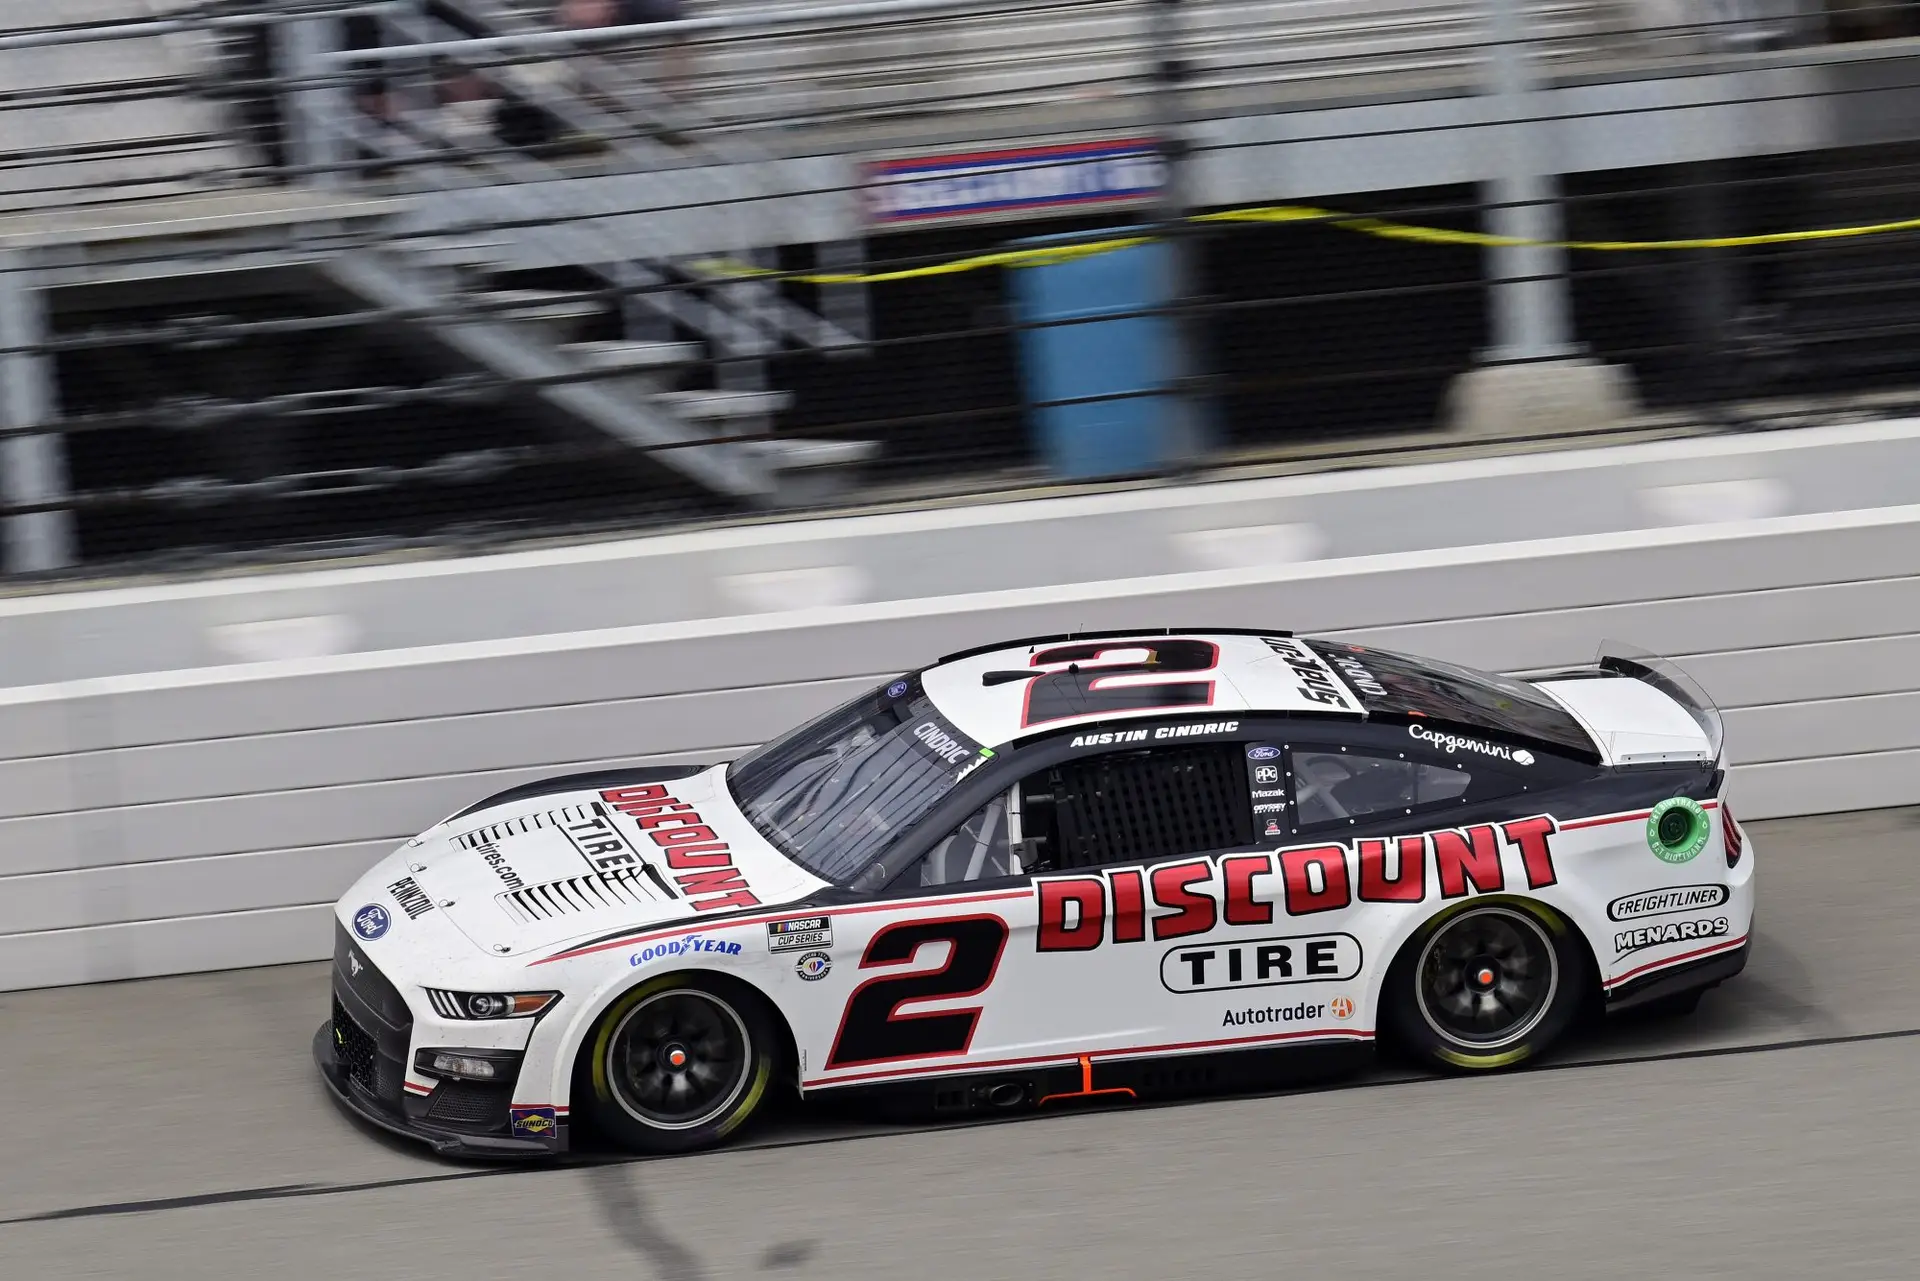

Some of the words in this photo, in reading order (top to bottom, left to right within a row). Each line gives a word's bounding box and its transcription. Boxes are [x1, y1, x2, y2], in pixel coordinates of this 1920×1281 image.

[1020, 639, 1220, 729] 2
[913, 721, 970, 764] CINDRIC
[1070, 729, 1149, 748] AUSTIN
[1154, 721, 1239, 739] CINDRIC
[1408, 724, 1512, 760] Capgemini
[1257, 767, 1276, 780] PPG
[1251, 788, 1285, 798] Mazak
[568, 818, 643, 880] TIRE
[599, 784, 763, 912] DISCOUNT
[476, 842, 525, 891] tires.com
[1034, 815, 1559, 953] DISCOUNT
[386, 876, 435, 921] PENNZOIL
[1617, 889, 1718, 916] FREIGHTLINER
[355, 906, 386, 936] Ford
[778, 935, 794, 946] CUP
[795, 932, 823, 943] SERIES
[788, 919, 821, 931] NASCAR
[1614, 917, 1729, 953] MENARDS
[1180, 940, 1339, 985] TIRE
[823, 912, 1009, 1071] 2
[1222, 1002, 1325, 1027] Autotrader
[515, 1118, 555, 1128] SUNOCO
